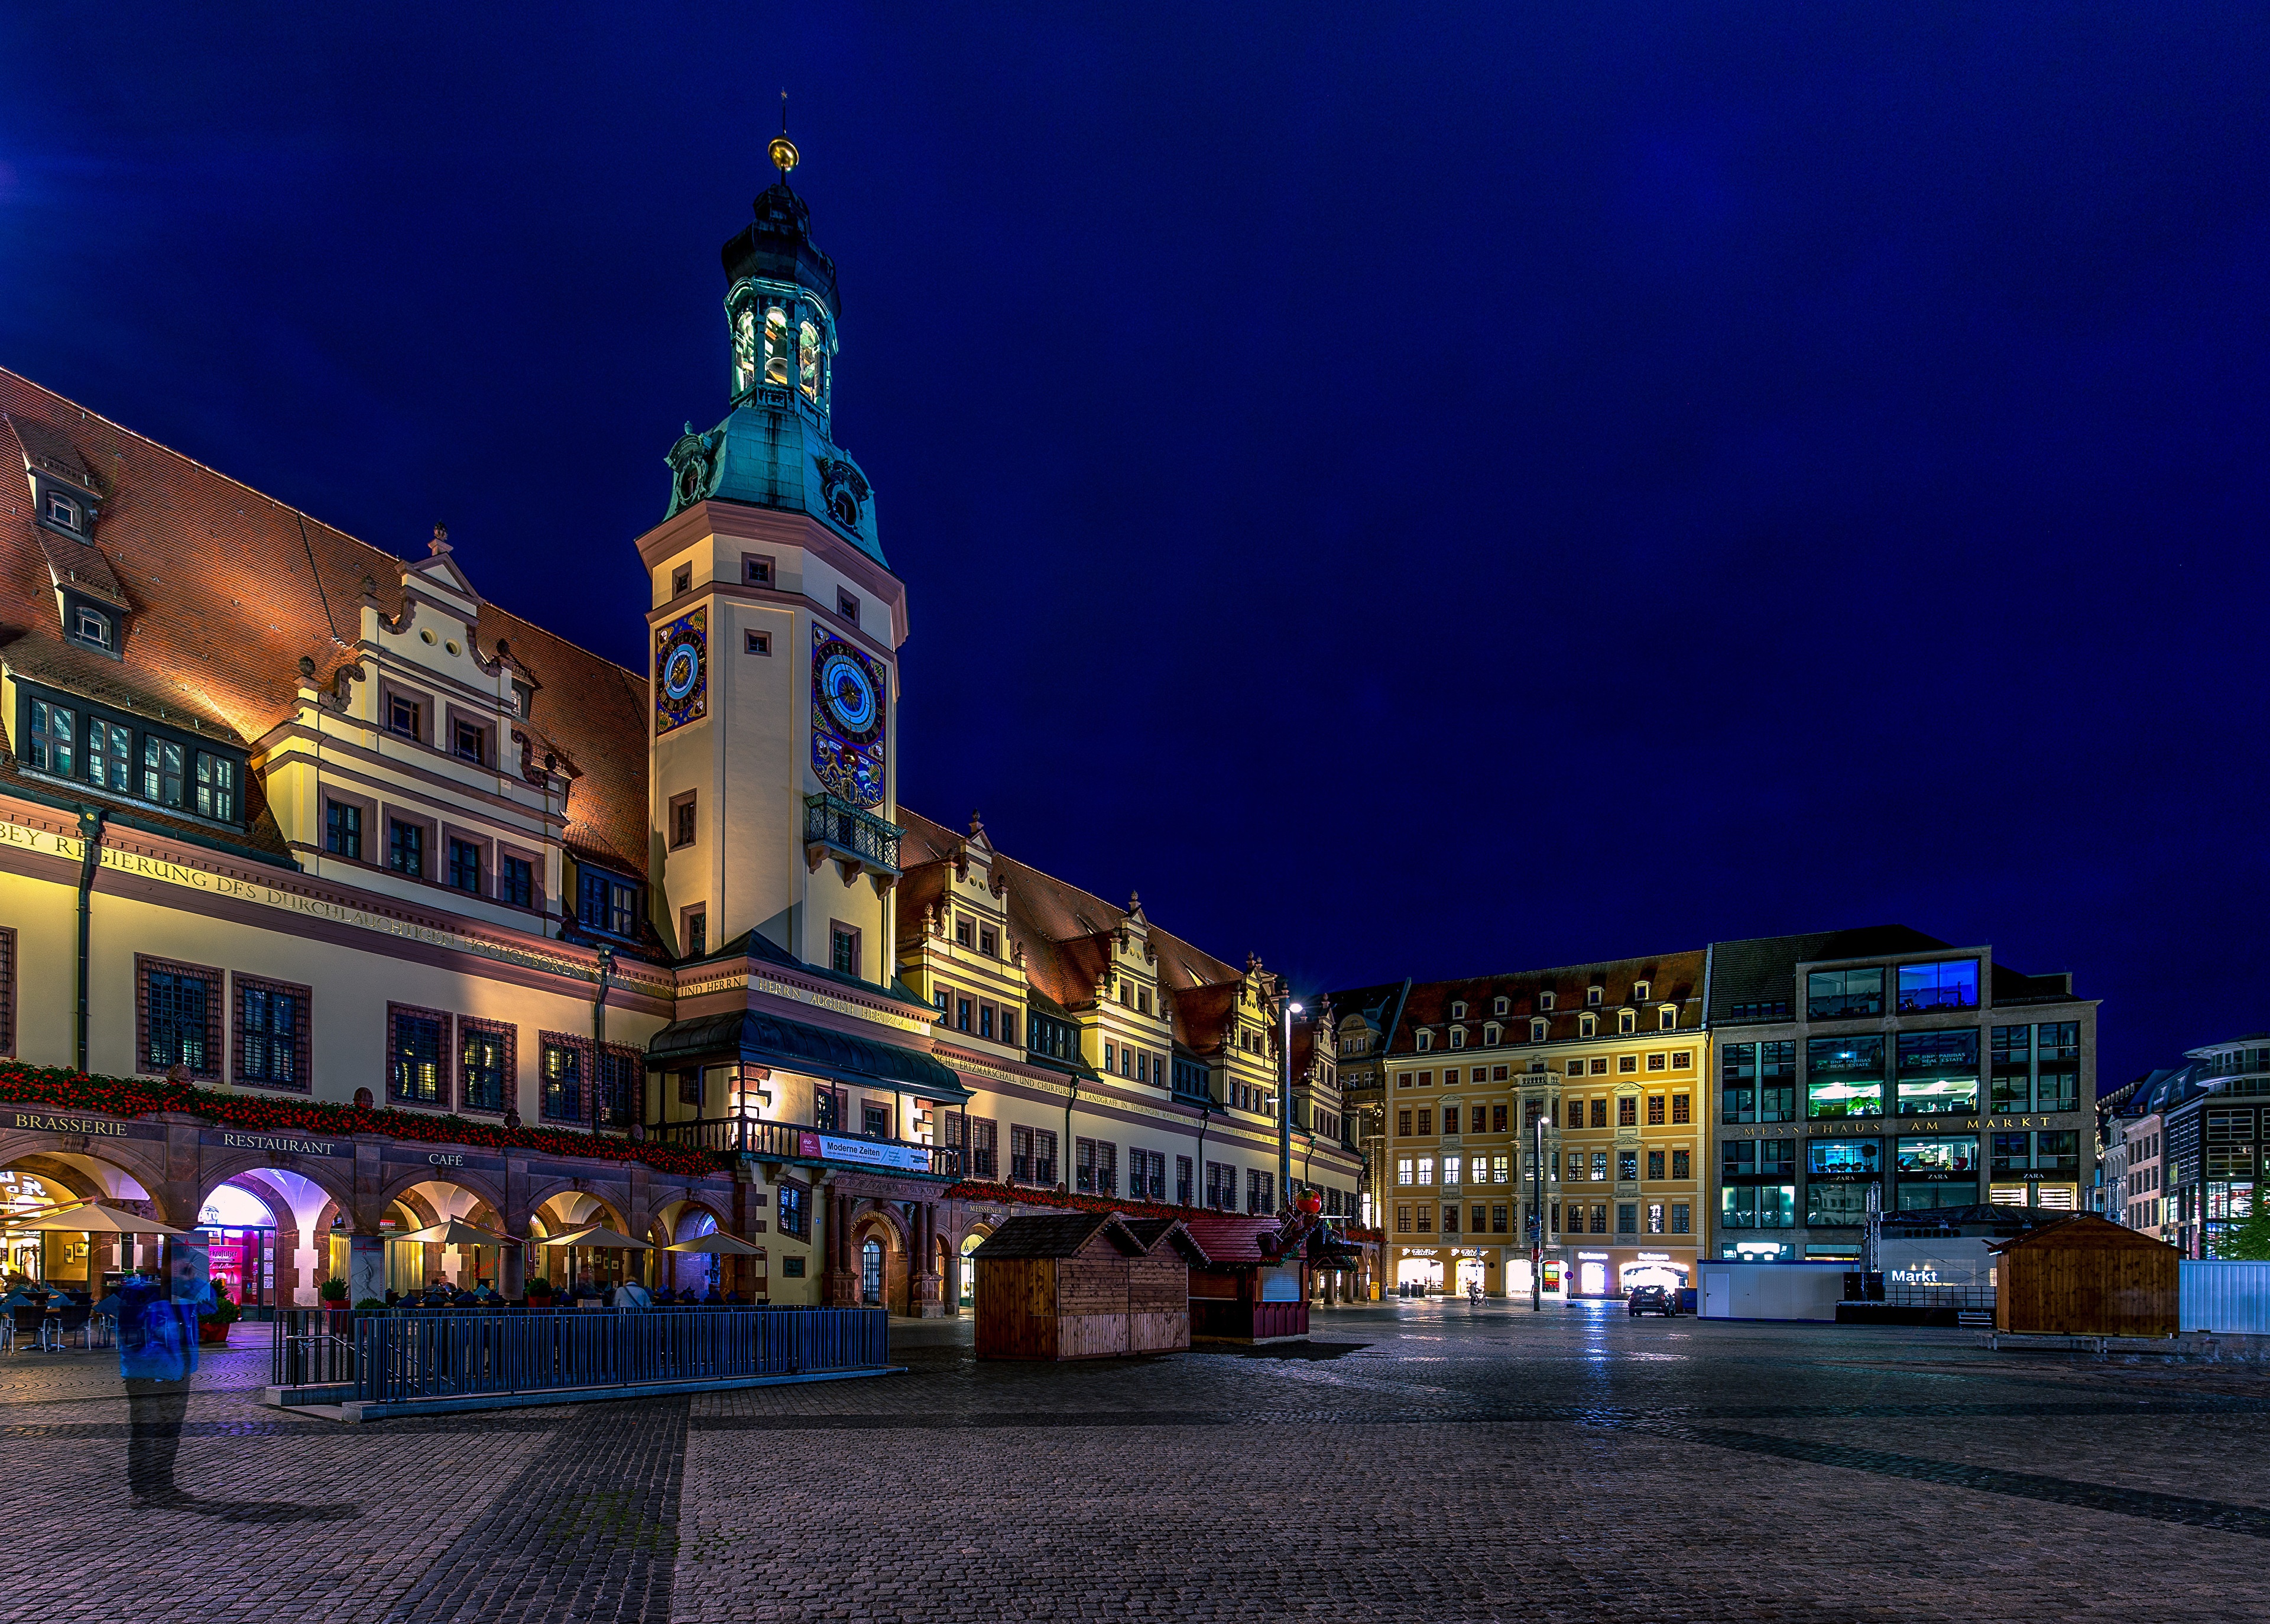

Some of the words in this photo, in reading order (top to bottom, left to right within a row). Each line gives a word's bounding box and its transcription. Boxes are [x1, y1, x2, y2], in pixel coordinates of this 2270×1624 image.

[216, 877, 256, 899] DES
[267, 889, 455, 947] DURCHLAUCHTIGEN
[463, 938, 602, 982] HOCHGEBORENEN
[681, 985, 702, 997] UND
[707, 977, 742, 992] HERRN
[758, 978, 800, 999] HERRN
[810, 994, 854, 1014] AUGUSTI
[861, 1007, 921, 1032] HERTZOGEN
[959, 1061, 1017, 1083] ERTZMARSCHALL
[1019, 1077, 1035, 1087] UND
[1037, 1081, 1081, 1098] CHURFURSTN
[1085, 1093, 1118, 1107] LANDGRAFF
[15, 1114, 128, 1136] BRASSERIE
[1744, 1123, 1880, 1136] MESSEHAUS
[1911, 1121, 1939, 1131] AM
[1967, 1116, 2051, 1130] MARKT
[223, 1133, 335, 1155] RESTAURANT
[827, 1142, 858, 1153] Moderne
[859, 1146, 880, 1157] Zeiten
[429, 1153, 463, 1166] CAFÉ
[969, 1204, 1003, 1214] MEISSENER
[1892, 1270, 1938, 1283] Markt
